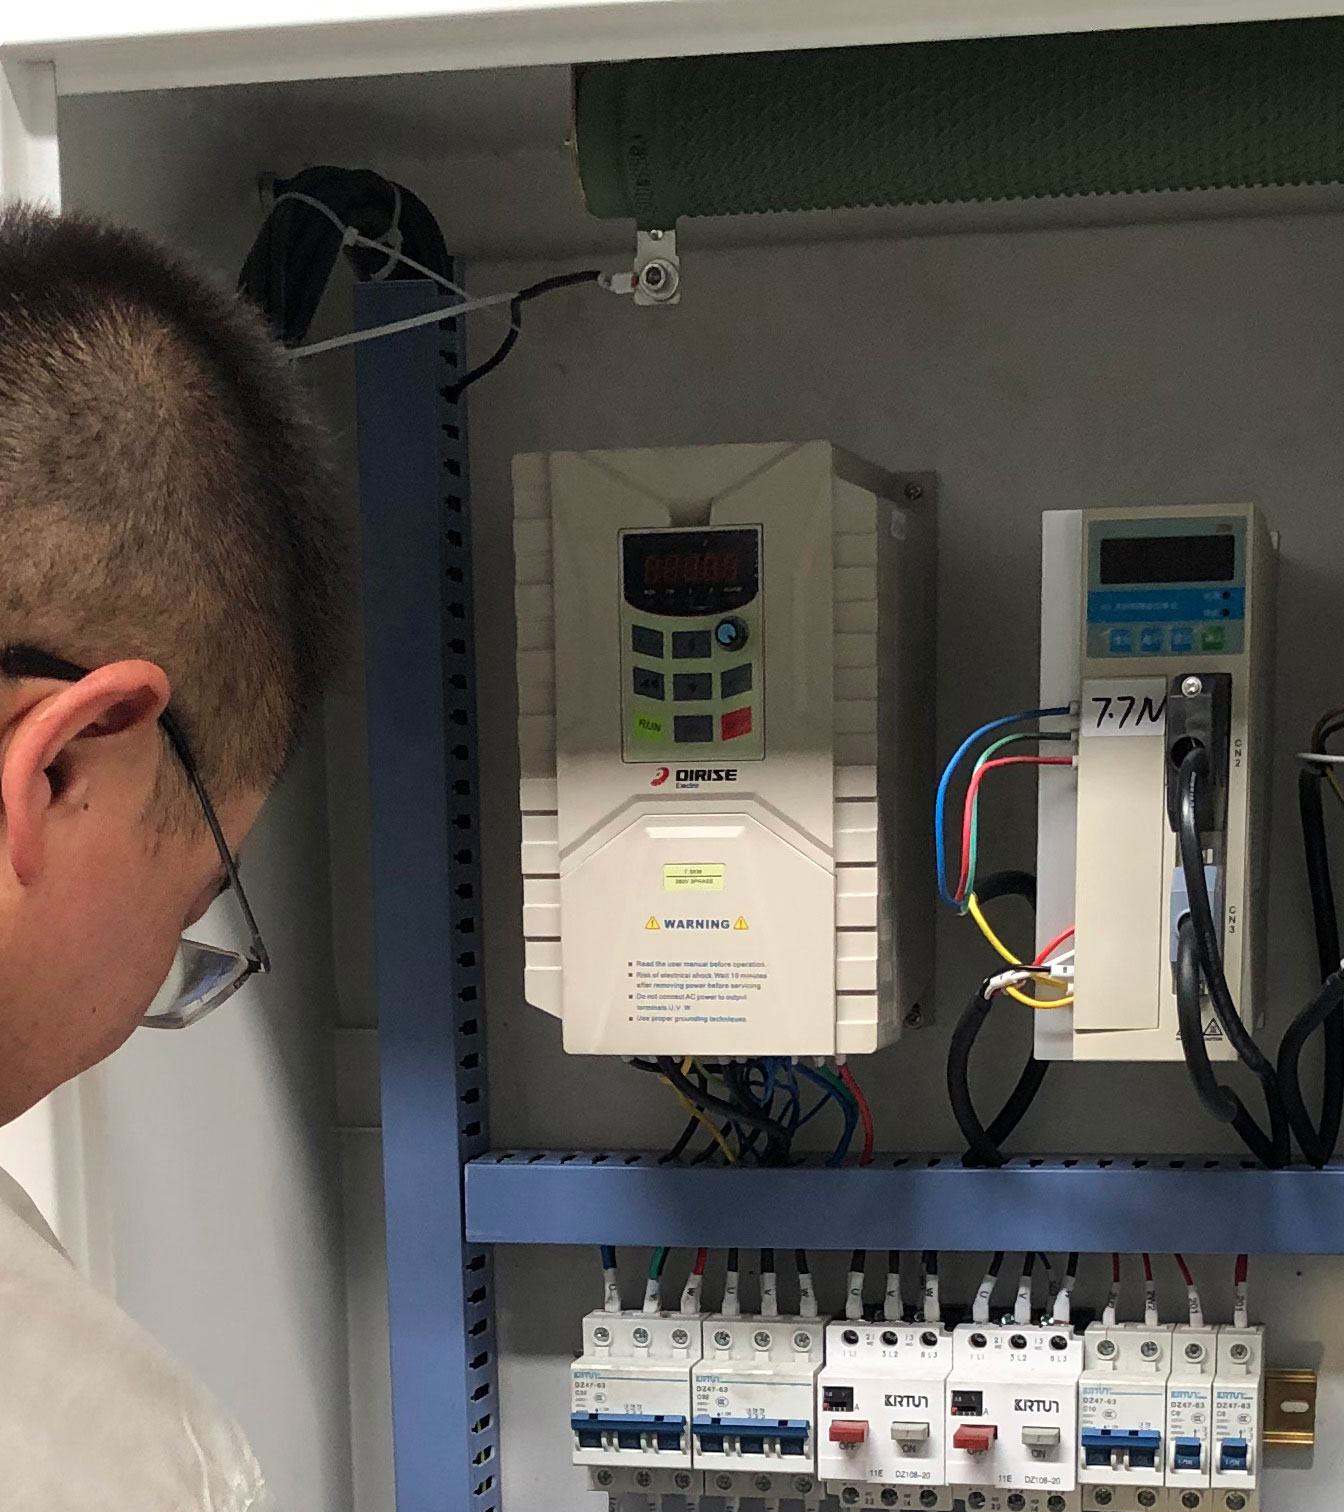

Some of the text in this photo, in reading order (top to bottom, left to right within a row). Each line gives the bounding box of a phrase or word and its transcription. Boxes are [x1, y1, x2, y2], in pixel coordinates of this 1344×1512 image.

[638, 719, 662, 731] RUN
[676, 769, 738, 782] DIRISE
[664, 918, 730, 930] WARNING
[902, 1444, 916, 1452] ON
[1031, 1450, 1046, 1458] ON
